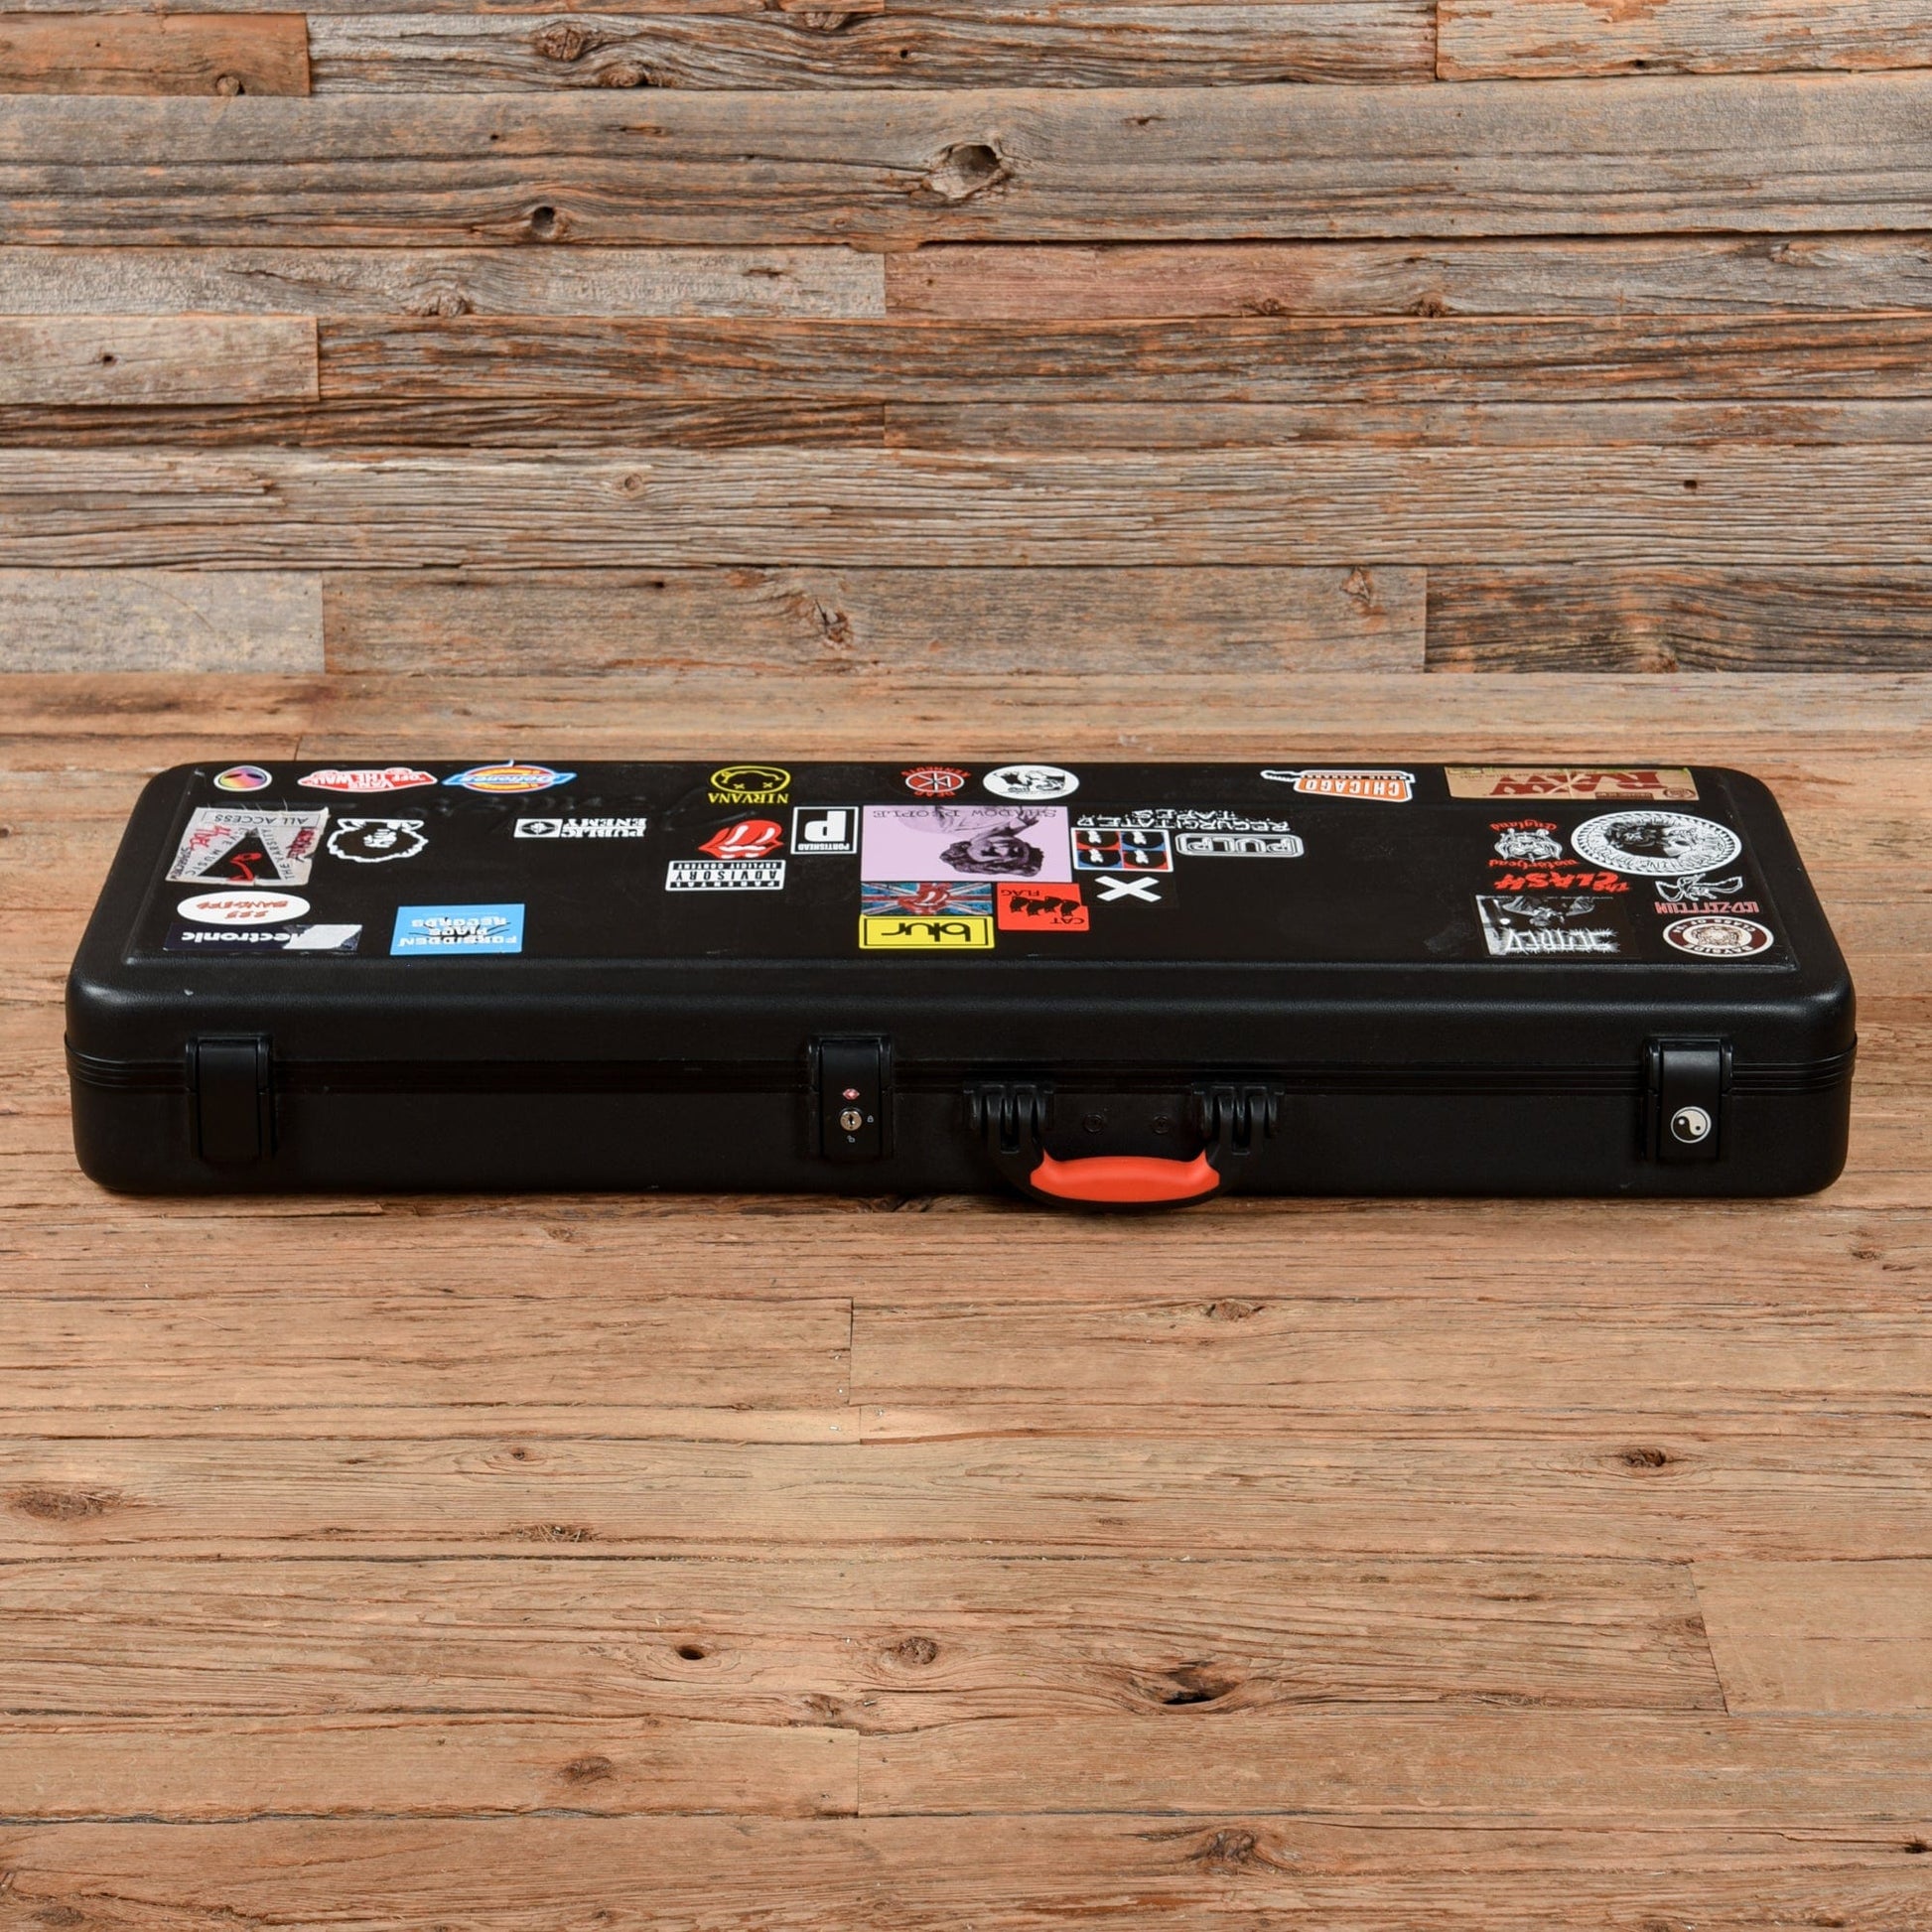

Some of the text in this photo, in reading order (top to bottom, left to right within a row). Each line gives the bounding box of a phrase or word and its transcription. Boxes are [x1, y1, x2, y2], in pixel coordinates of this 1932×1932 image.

[1306, 780, 1400, 796] CHICAGO
[1490, 771, 1668, 795] RAW
[708, 792, 789, 804] NIRVANA
[213, 814, 309, 826] ALL ACCESS
[873, 809, 1057, 818] SHADOW PEOPLE
[562, 818, 647, 828] ENEMY
[804, 811, 846, 842] P
[560, 827, 645, 838] PUBLIC
[261, 828, 284, 862] VARSITY
[1187, 838, 1292, 854] PULP
[184, 849, 221, 878] MUSIC
[674, 871, 777, 881] ADVISORY
[1493, 872, 1619, 892] CLASH
[410, 916, 507, 927] RECORDS
[1714, 918, 1755, 933] CLASS
[883, 922, 972, 943] blur
[396, 934, 517, 947] FORBIDDEN
[1683, 944, 1753, 954] BAYSIDE
